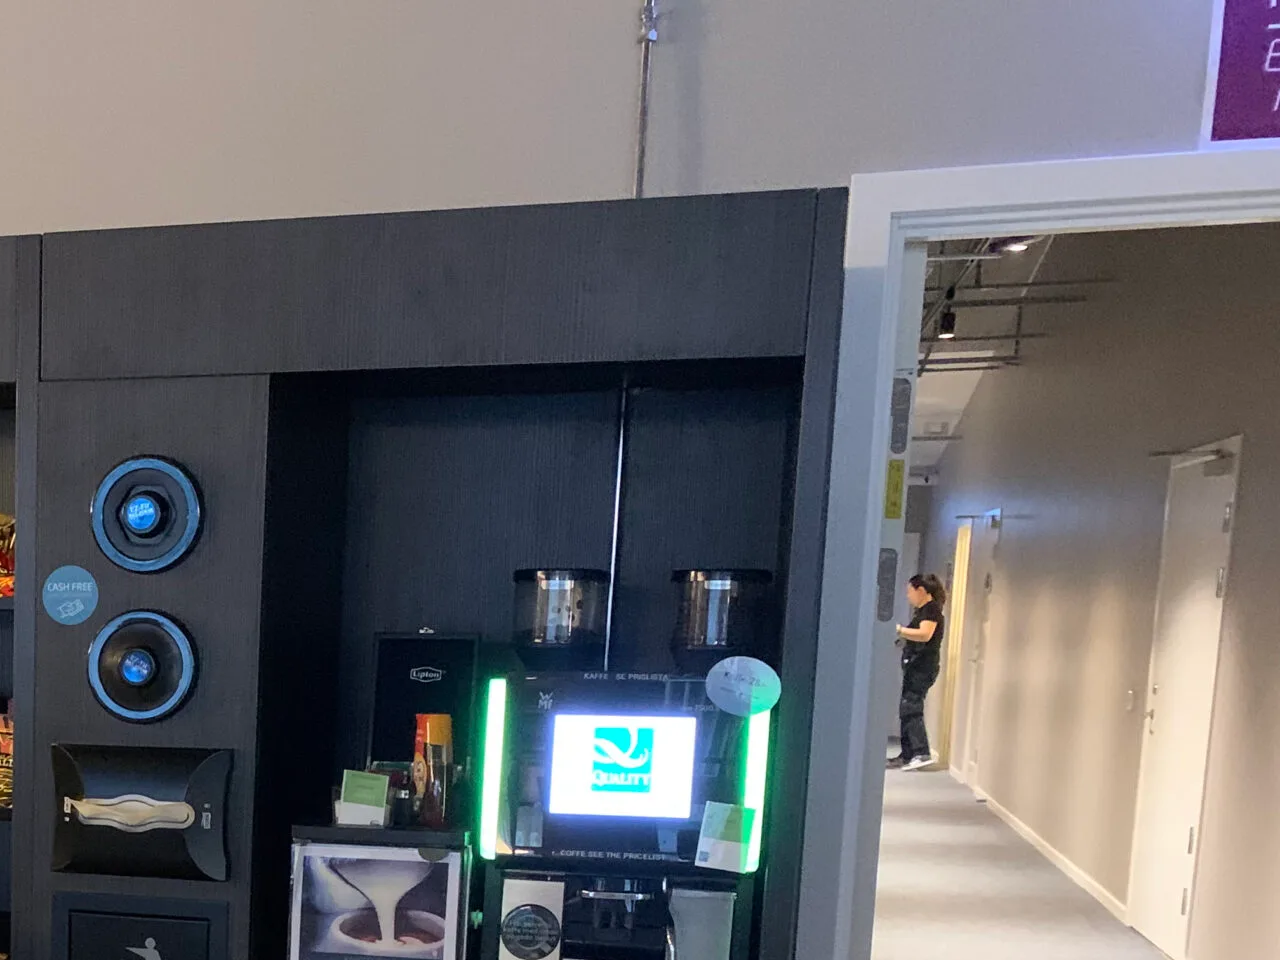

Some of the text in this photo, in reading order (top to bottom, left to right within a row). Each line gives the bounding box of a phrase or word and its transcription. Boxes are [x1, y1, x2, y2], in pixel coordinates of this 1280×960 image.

[47, 582, 94, 592] CASH FREE
[412, 670, 440, 679] Lipton
[592, 769, 651, 787] QUALITY
[606, 851, 620, 859] THE
